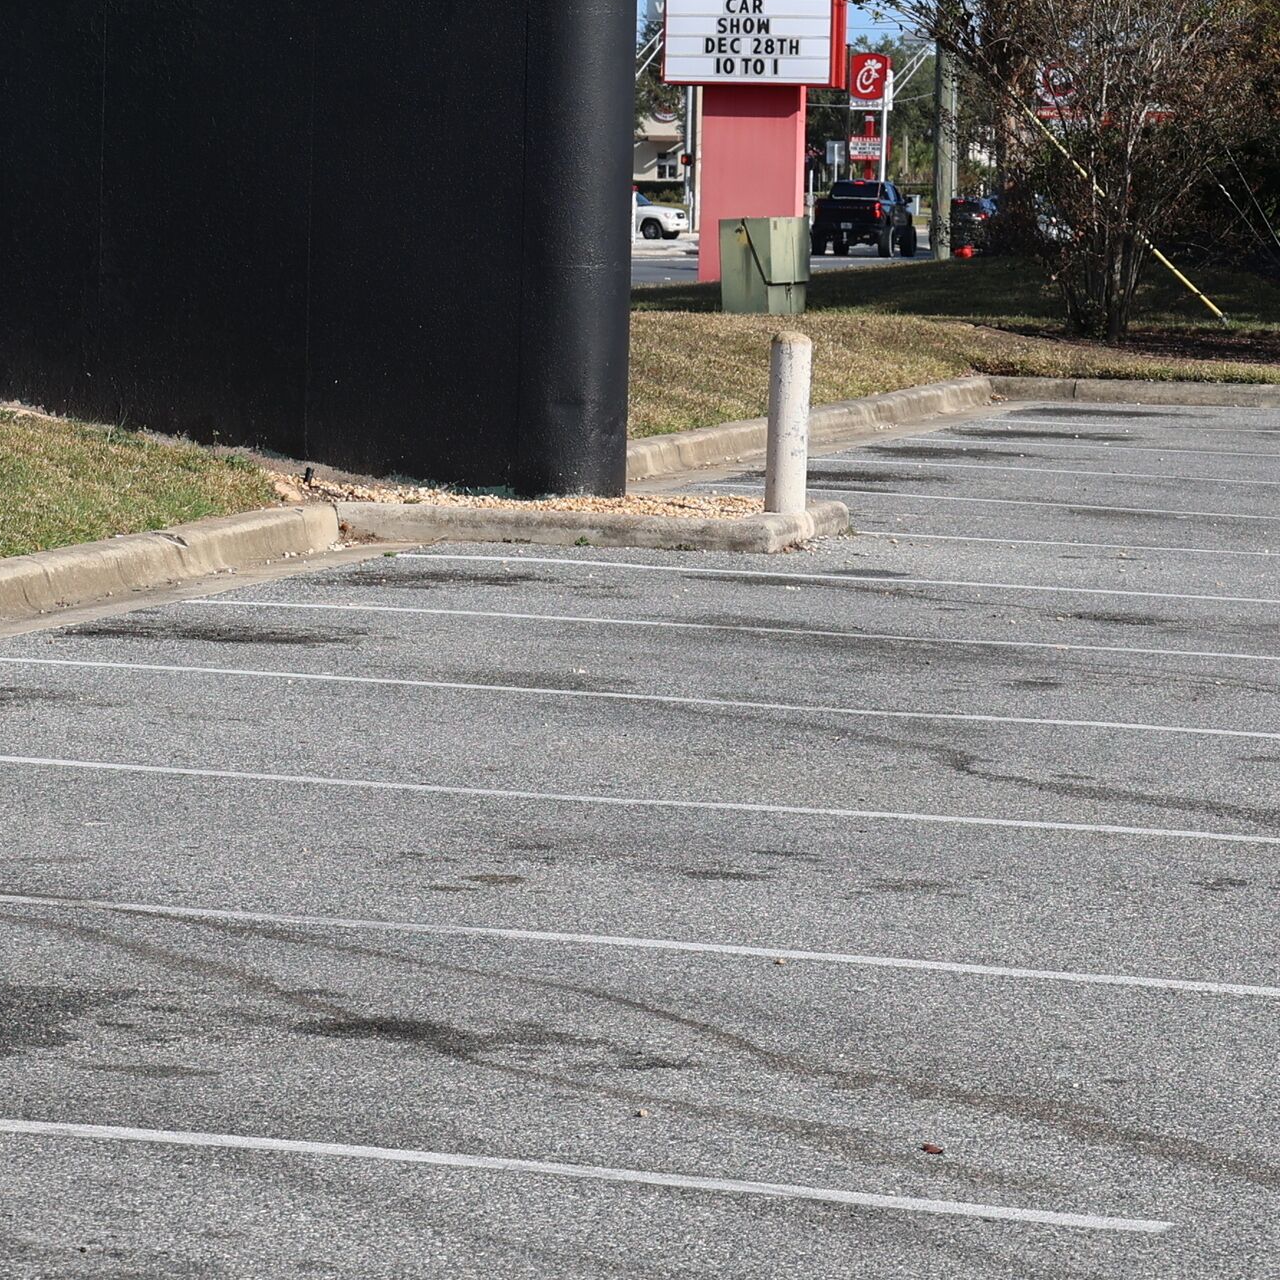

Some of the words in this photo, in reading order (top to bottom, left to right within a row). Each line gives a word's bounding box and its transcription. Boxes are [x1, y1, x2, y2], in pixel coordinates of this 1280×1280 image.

[717, 18, 770, 34] SHOW
[705, 38, 740, 54] DEC
[752, 38, 800, 55] 28TH
[716, 58, 735, 74] 10
[741, 58, 765, 75] TO
